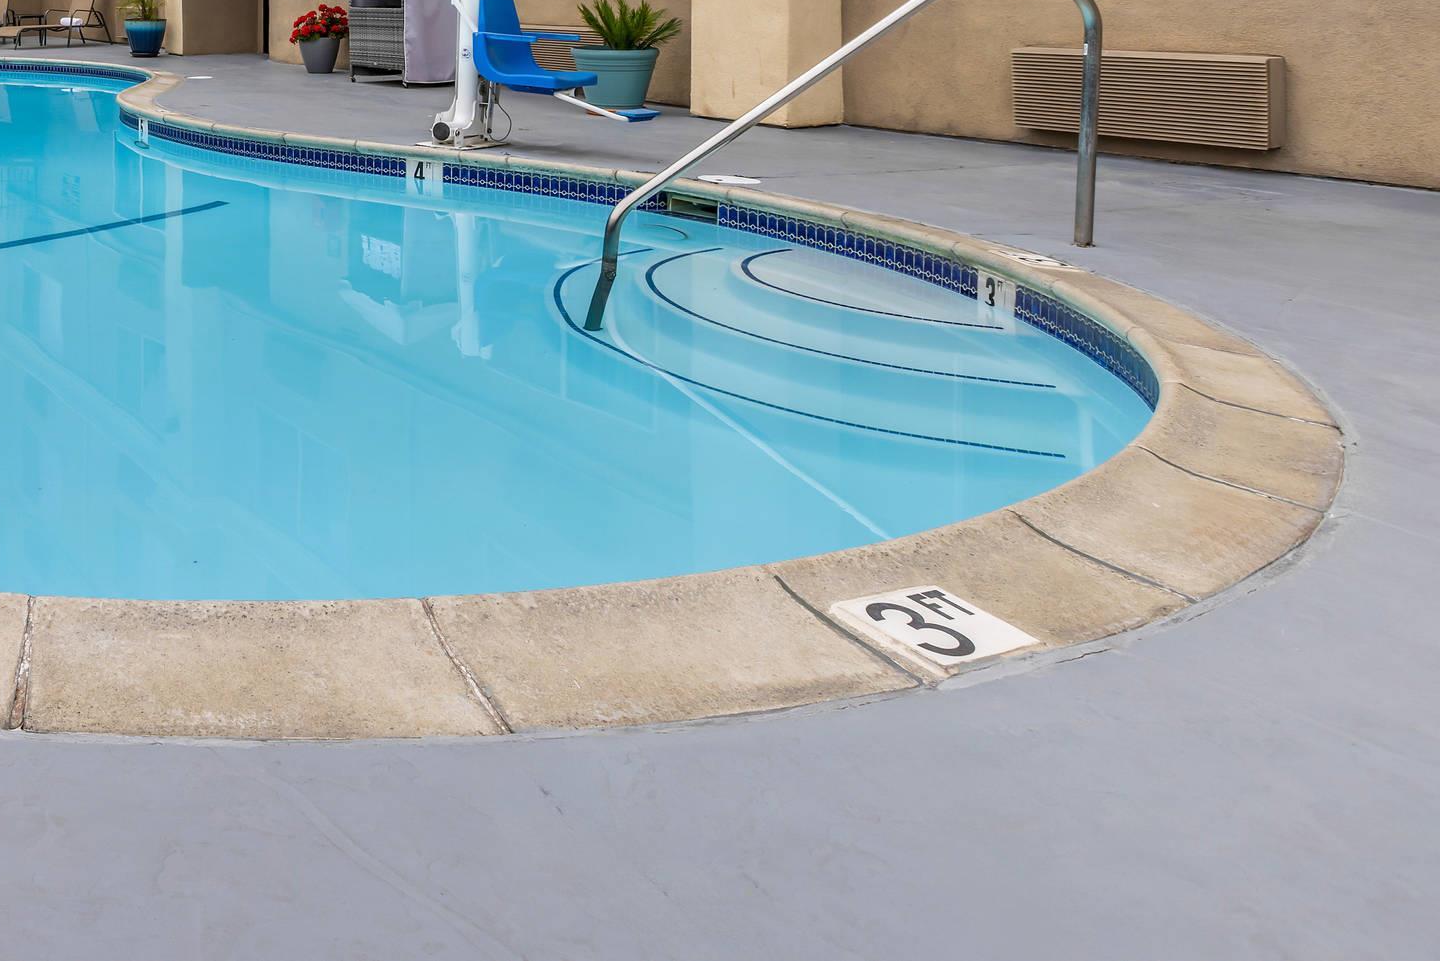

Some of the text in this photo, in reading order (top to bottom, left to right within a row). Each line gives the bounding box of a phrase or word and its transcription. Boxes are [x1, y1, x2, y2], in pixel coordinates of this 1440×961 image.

[414, 161, 425, 179] 4
[985, 277, 995, 306] 3
[865, 589, 976, 657] 3 FT
